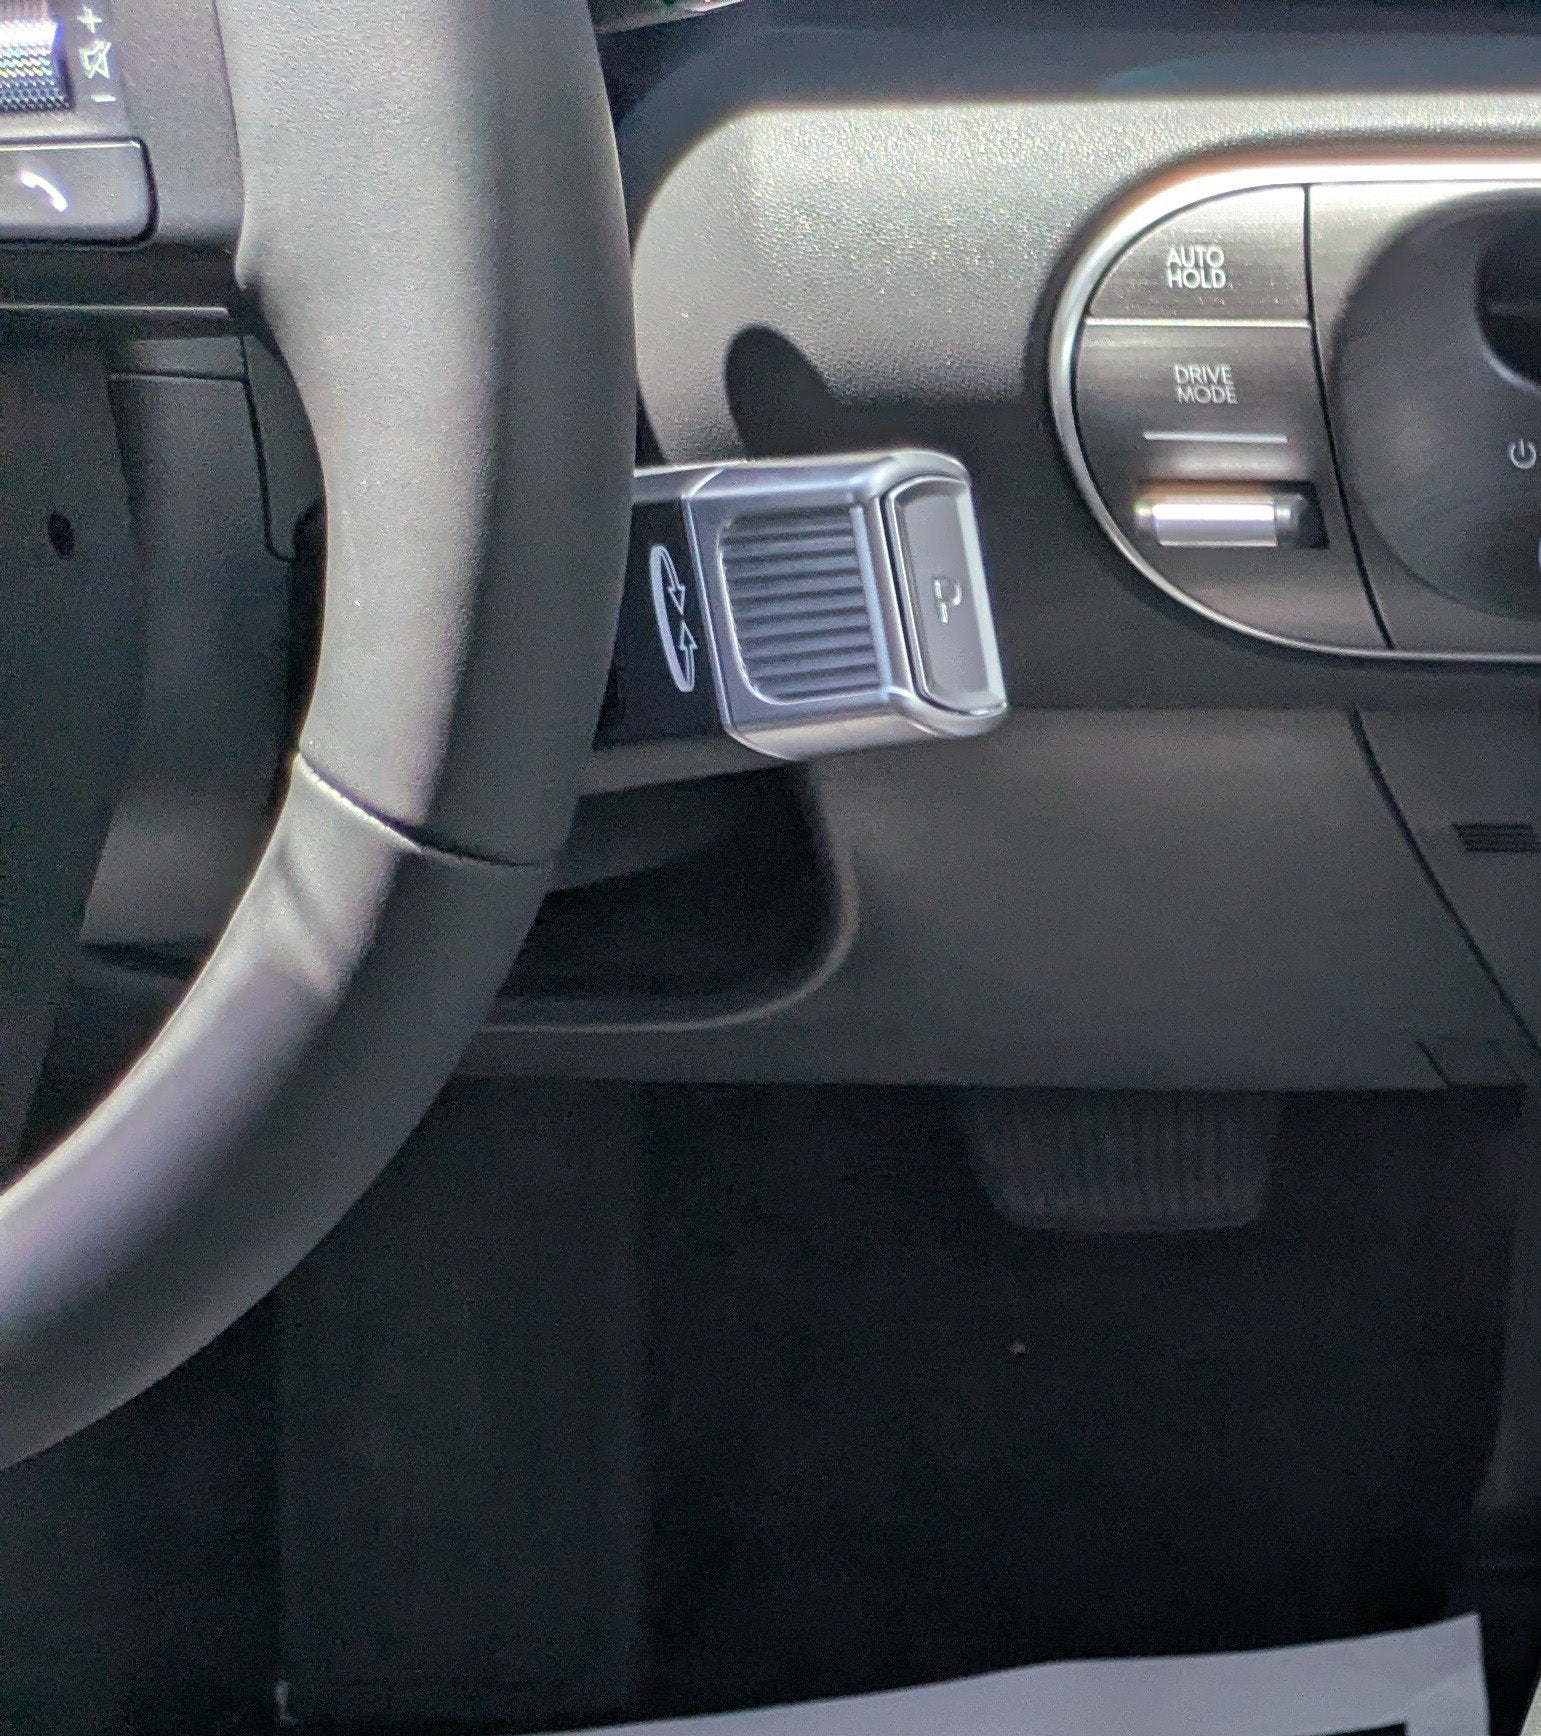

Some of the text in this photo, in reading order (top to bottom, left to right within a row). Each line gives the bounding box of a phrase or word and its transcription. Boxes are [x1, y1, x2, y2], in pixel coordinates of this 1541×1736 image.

[1166, 245, 1225, 268] AUTO
[1166, 267, 1227, 289] HOLD
[1173, 363, 1233, 385] DRIVE
[1176, 385, 1239, 404] MODE
